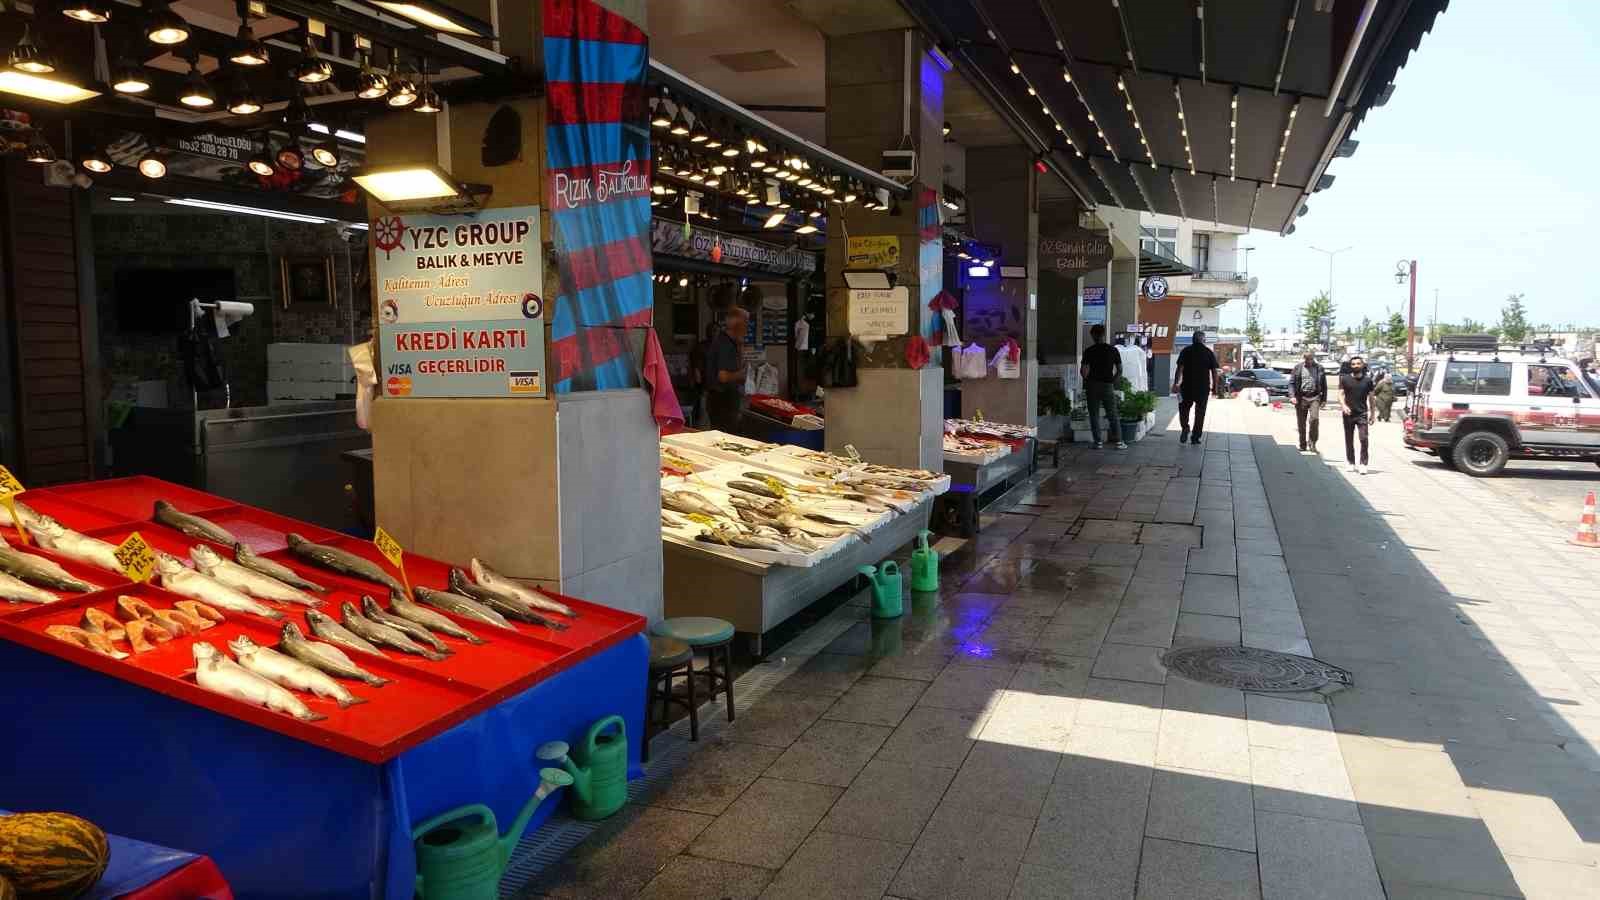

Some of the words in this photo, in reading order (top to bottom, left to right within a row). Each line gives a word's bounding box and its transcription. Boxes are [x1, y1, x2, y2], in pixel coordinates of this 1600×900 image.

[554, 172, 592, 209] RIZIK
[410, 226, 449, 250] YZC
[455, 221, 531, 247] GROUP
[416, 254, 457, 270] BALIK
[460, 254, 471, 267] &
[473, 250, 525, 266] MEYVE
[383, 276, 431, 294] Kalitenin
[439, 274, 470, 288] Adresi
[484, 290, 519, 305] Adresi
[396, 327, 457, 352] KREDİ
[463, 329, 527, 349] KARTI
[387, 362, 412, 375] VISA
[417, 356, 506, 376] GEÇERLİDİR
[514, 377, 535, 387] VISA
